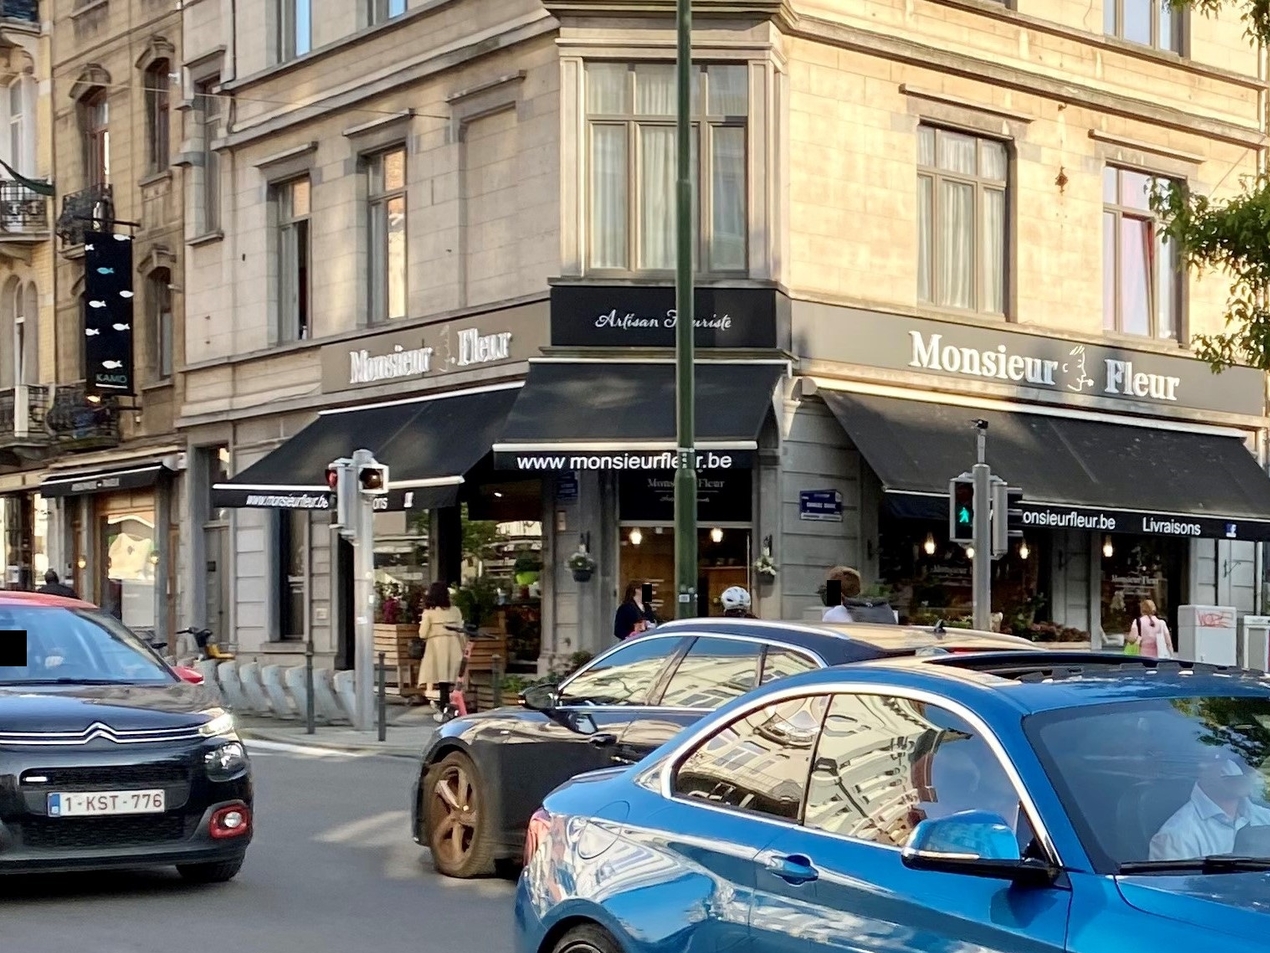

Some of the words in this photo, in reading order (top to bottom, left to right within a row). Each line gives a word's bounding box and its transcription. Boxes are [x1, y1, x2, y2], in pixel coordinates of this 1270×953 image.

[595, 309, 659, 330] Artisan
[663, 309, 732, 331] Furiste
[350, 345, 433, 384] Monsieur
[457, 328, 512, 366] Fleur
[909, 330, 1057, 386] Monsieur
[1103, 358, 1180, 401] Fleur
[95, 373, 128, 384] KAMO
[570, 452, 732, 470] monsieurfler.be
[1022, 510, 1116, 530] onsieurfleur.be
[1142, 517, 1201, 536] Livraisons
[64, 793, 163, 812] 1-KST-776
